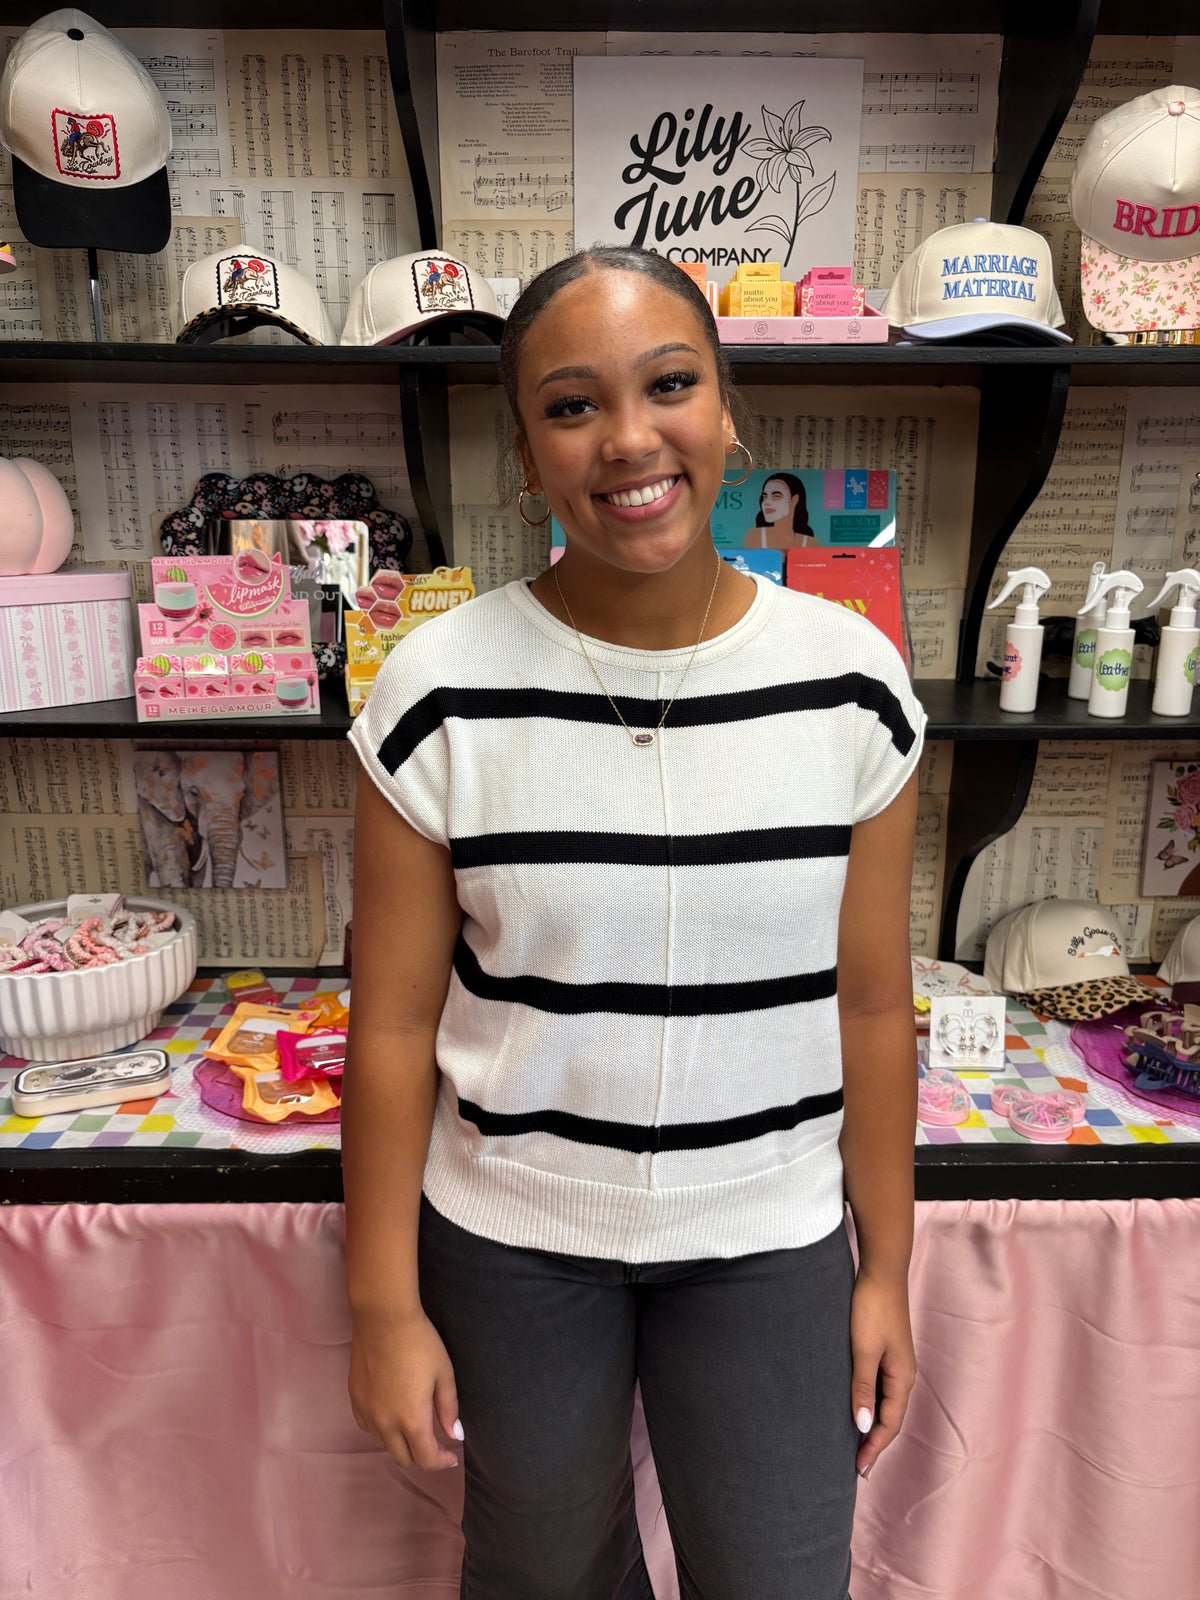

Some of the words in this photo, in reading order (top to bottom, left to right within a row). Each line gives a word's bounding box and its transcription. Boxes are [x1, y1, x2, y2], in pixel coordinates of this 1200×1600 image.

[488, 48, 506, 57] The
[510, 48, 550, 56] Barefoot
[621, 103, 752, 186] Lily
[614, 175, 764, 248] June
[1112, 198, 1200, 238] BRID
[666, 247, 773, 267] COMPANY
[941, 254, 1038, 278] MARRIAGE
[764, 296, 778, 304] you
[942, 278, 1036, 302] MATERIAL
[410, 589, 470, 610] HONEY
[380, 633, 405, 642] fashio
[168, 706, 207, 714] MEIKE
[210, 703, 272, 714] GLAMOUR
